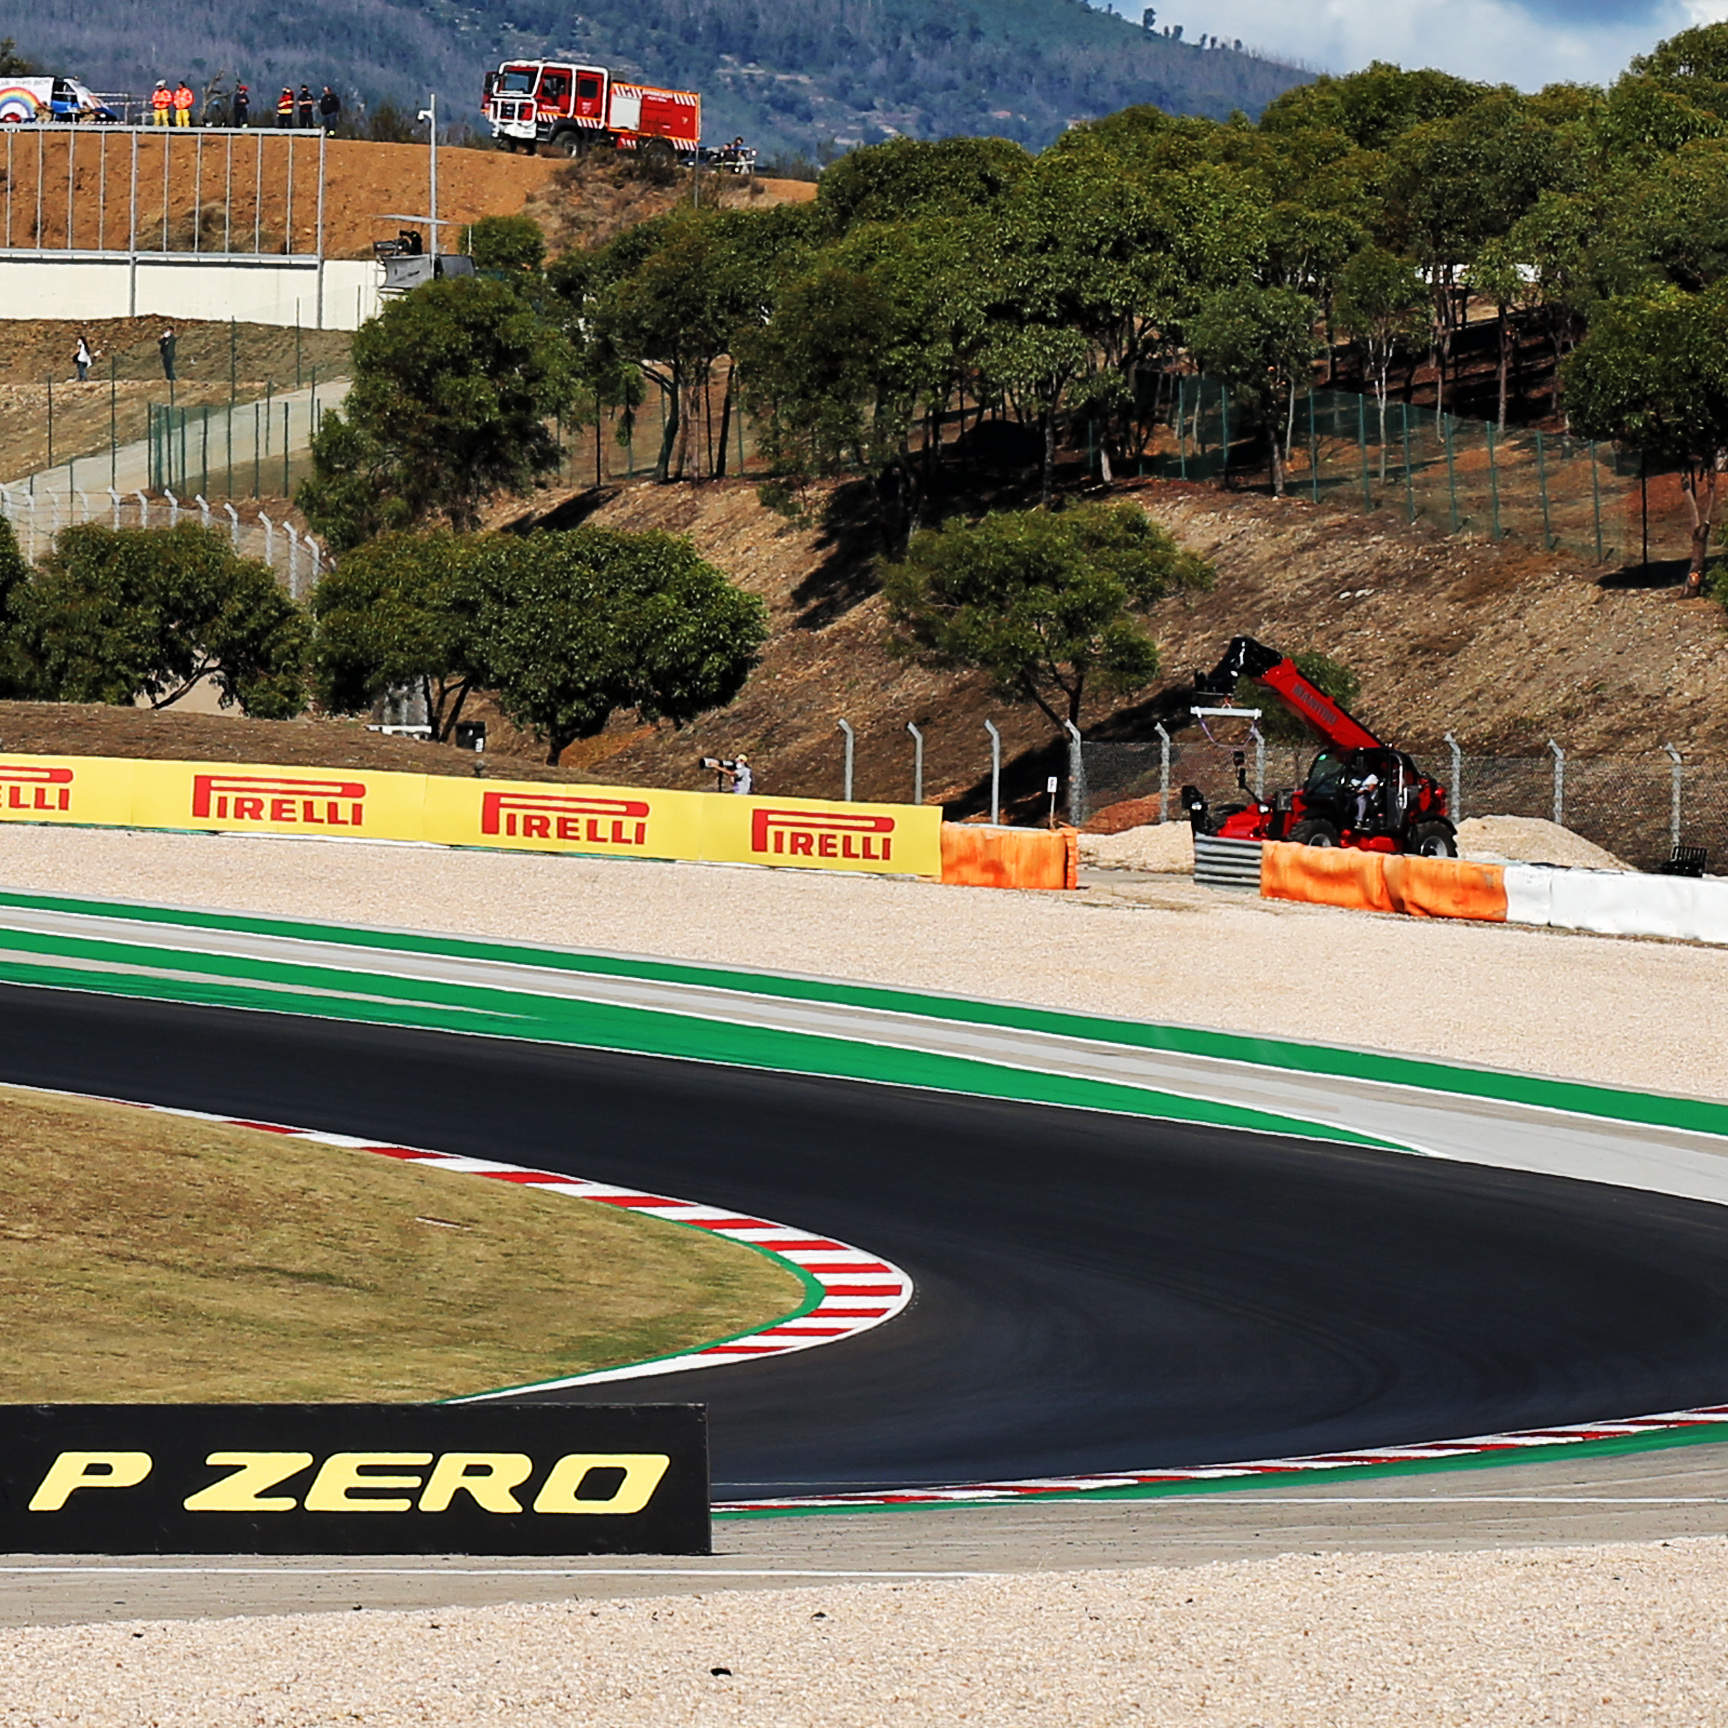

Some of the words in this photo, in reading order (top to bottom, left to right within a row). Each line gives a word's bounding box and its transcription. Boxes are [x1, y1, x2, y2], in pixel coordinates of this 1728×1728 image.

[192, 774, 366, 826] PIRELLI
[481, 791, 650, 845] PIRELLI
[751, 808, 896, 861] PIRELLI
[28, 1451, 152, 1511] P
[184, 1452, 670, 1514] ZERO
